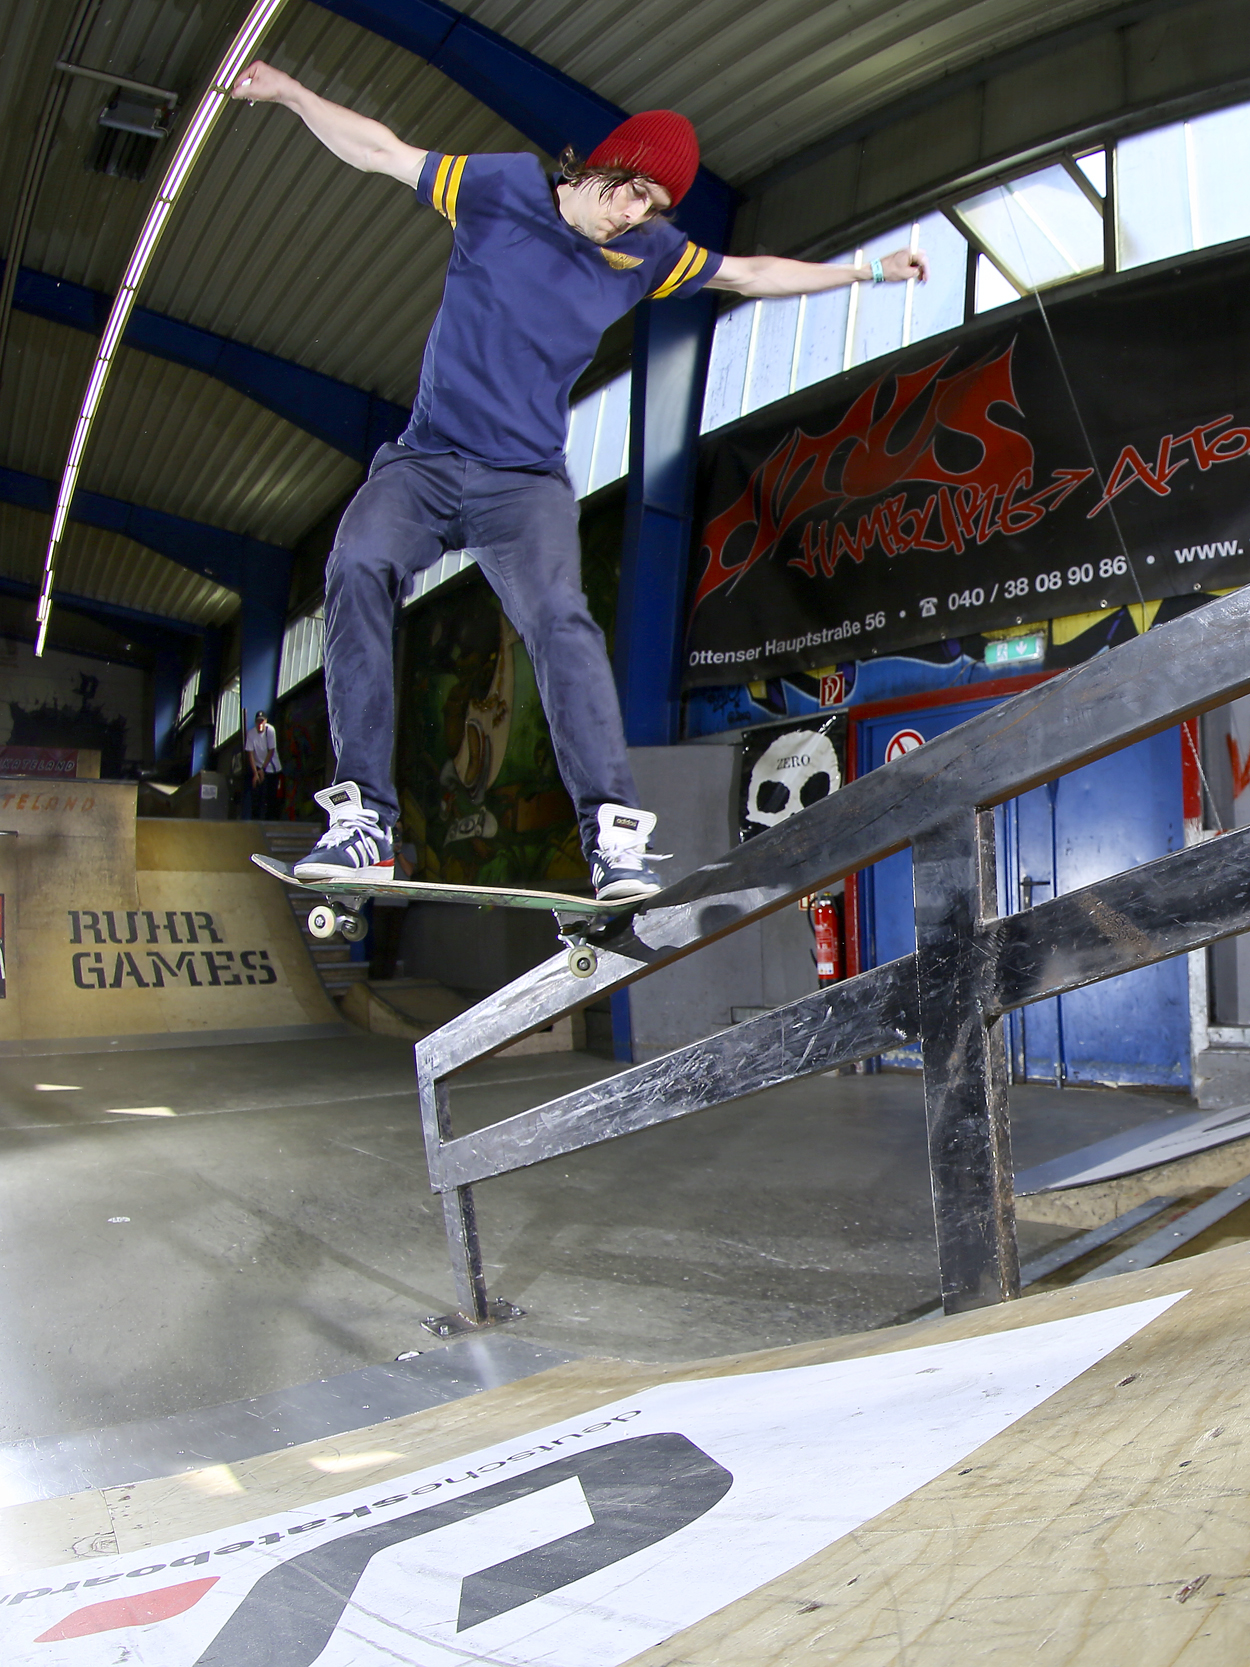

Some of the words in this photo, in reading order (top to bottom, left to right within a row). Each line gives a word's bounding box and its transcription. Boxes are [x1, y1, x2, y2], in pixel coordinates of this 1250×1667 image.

[788, 468, 1035, 578] HAMBURG
[689, 647, 762, 667] Ottenser
[765, 620, 861, 656] Hauptstraße
[865, 611, 886, 631] 56
[948, 587, 985, 611] 040
[1004, 577, 1029, 599] 38
[1035, 570, 1062, 593] 08
[1067, 563, 1094, 586] 90
[1099, 555, 1128, 578] 86
[0, 757, 76, 772] KATELAND
[776, 754, 811, 770] ZERO
[67, 910, 224, 944] RUHR
[72, 951, 278, 989] GAMES
